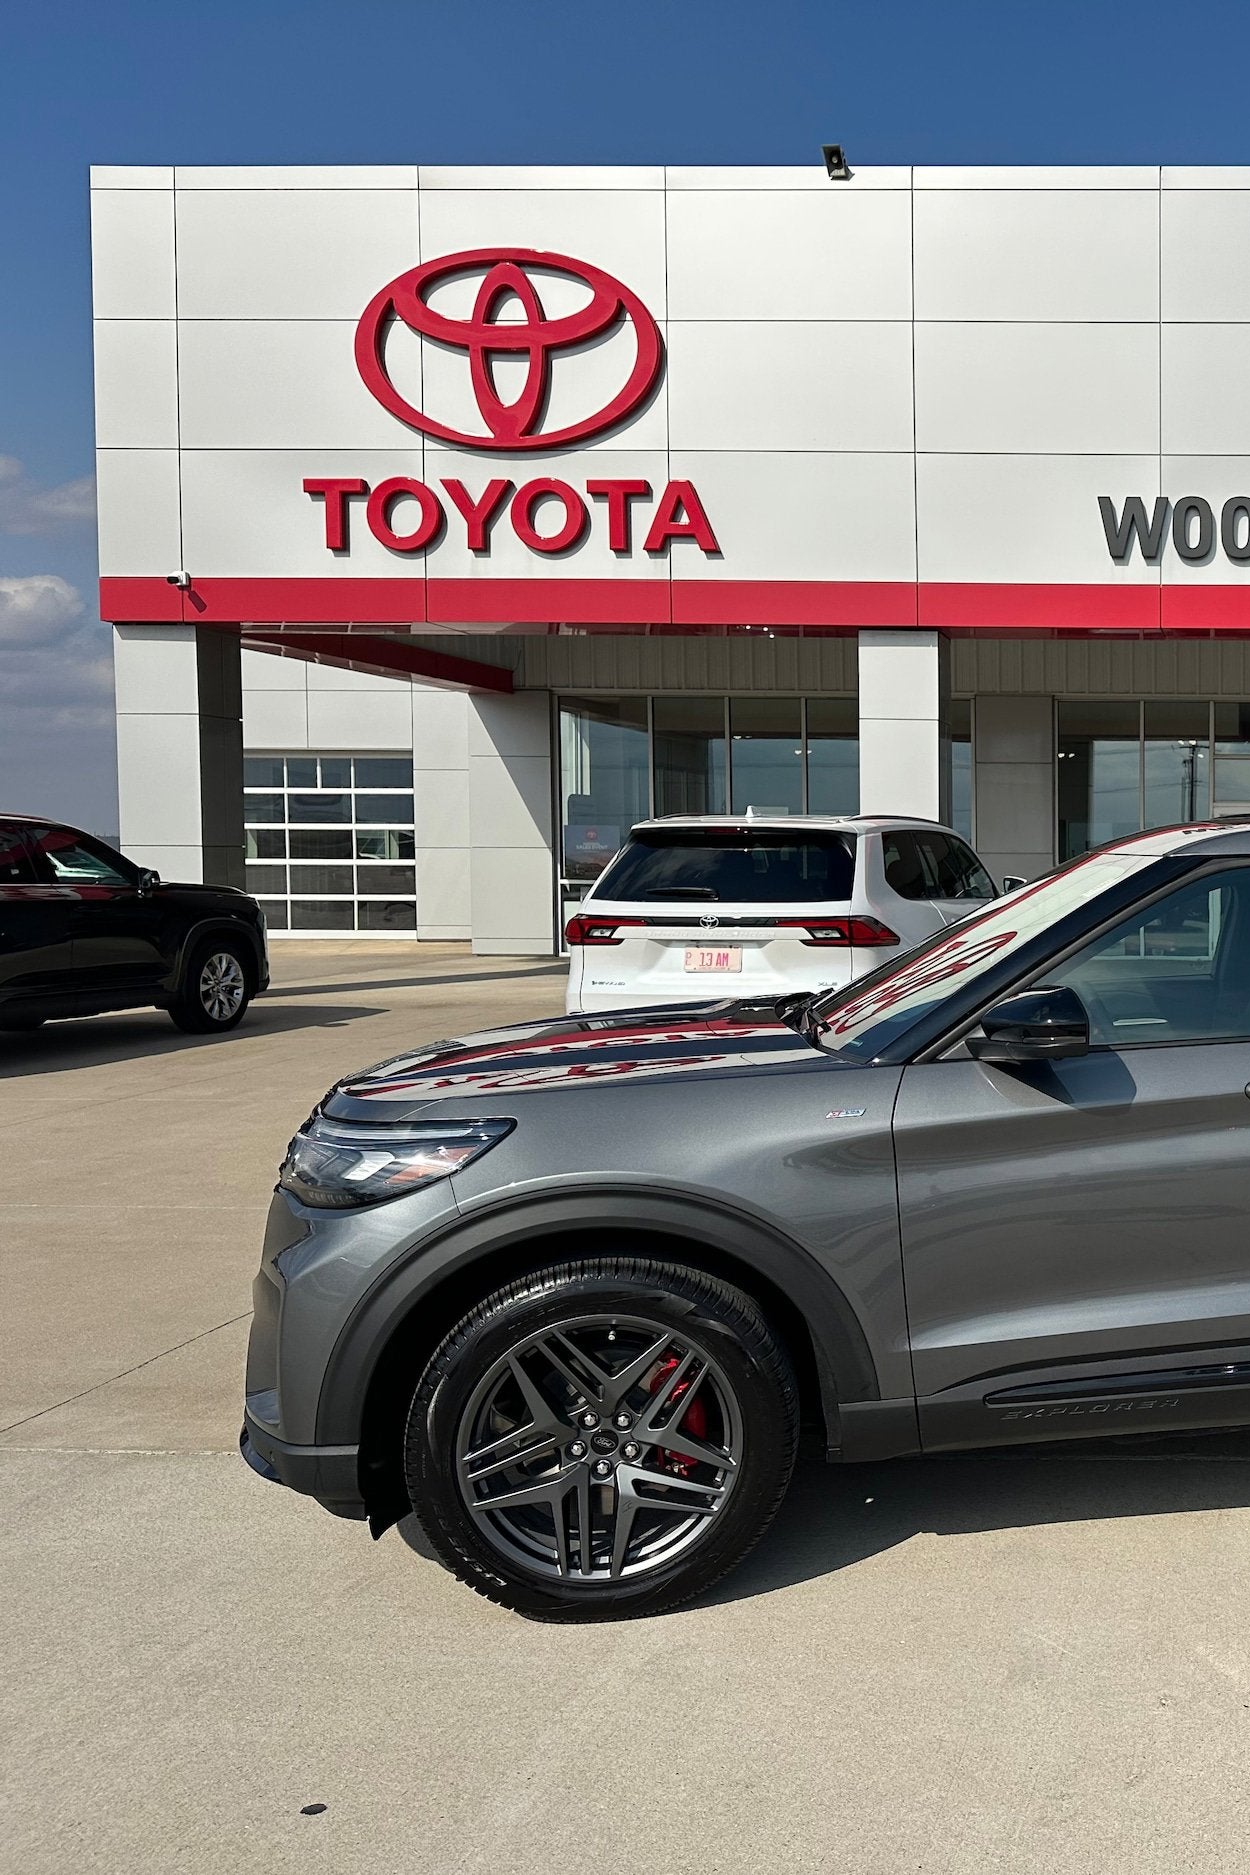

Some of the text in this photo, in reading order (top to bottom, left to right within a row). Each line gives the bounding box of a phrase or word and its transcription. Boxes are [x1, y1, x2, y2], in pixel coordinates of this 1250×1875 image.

[303, 476, 721, 553] TOYOTA
[699, 952, 713, 967] 13
[715, 952, 729, 967] AM
[1001, 1399, 1181, 1420] EXPLORER
